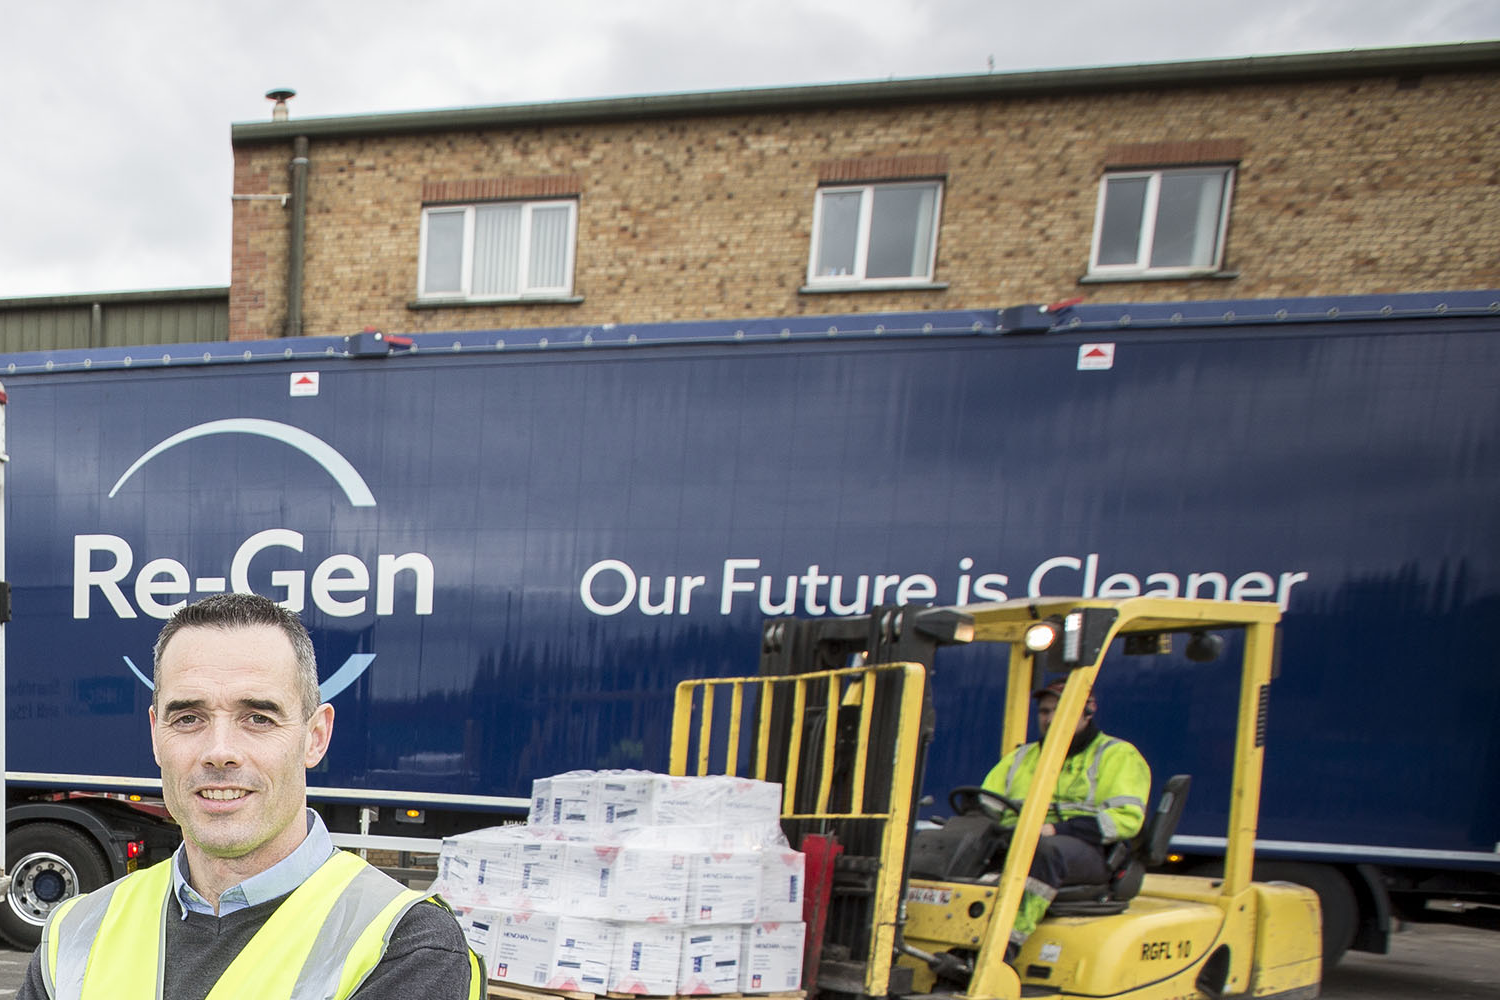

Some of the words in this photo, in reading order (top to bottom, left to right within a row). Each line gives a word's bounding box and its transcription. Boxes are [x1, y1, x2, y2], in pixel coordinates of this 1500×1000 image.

[73, 528, 436, 620] Re-Gen
[580, 559, 706, 616] Our
[720, 558, 937, 616] Future
[956, 557, 1009, 607] is
[1028, 553, 1309, 613] Cleaner
[1141, 941, 1172, 961] RGFL
[1177, 940, 1193, 959] 10
